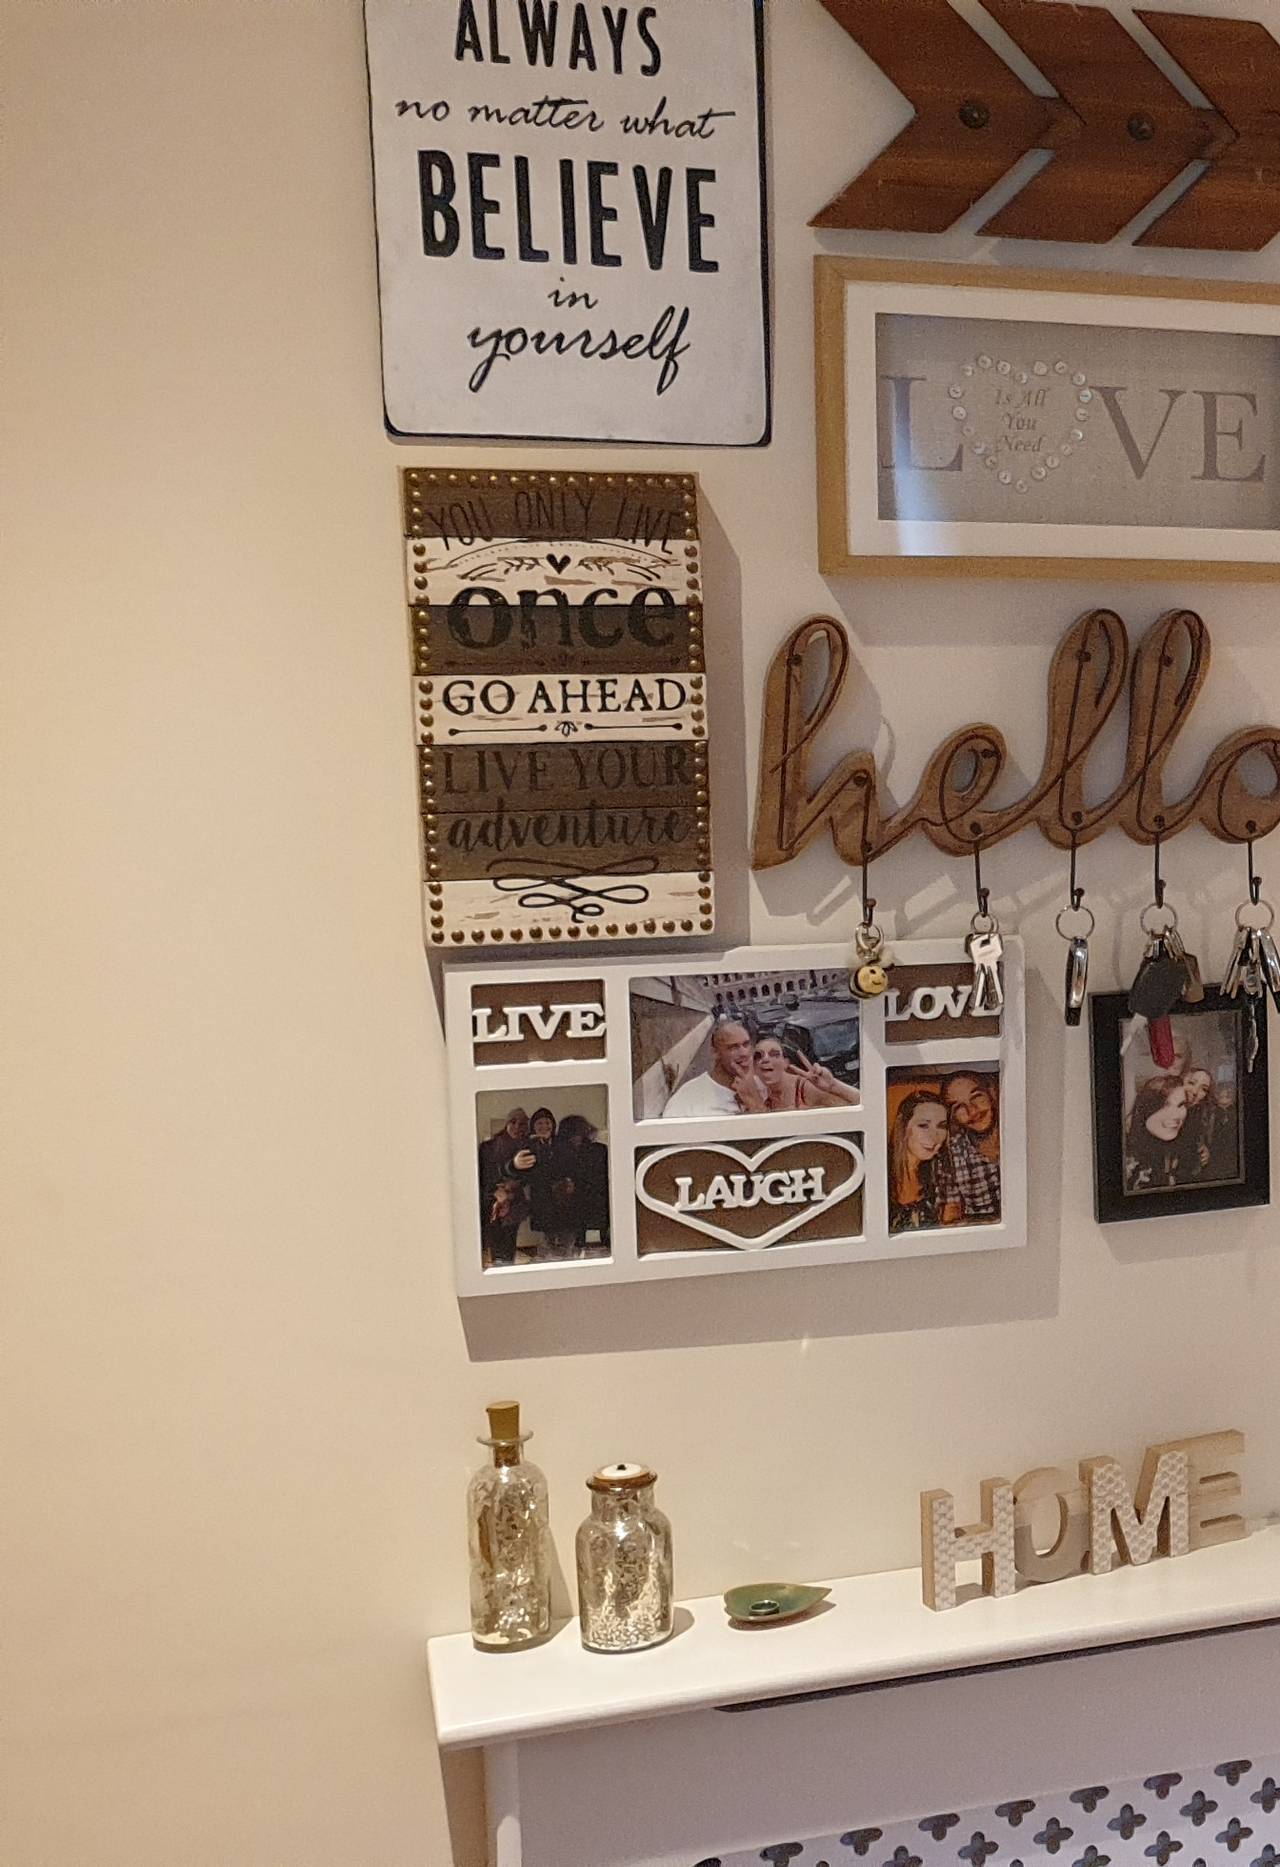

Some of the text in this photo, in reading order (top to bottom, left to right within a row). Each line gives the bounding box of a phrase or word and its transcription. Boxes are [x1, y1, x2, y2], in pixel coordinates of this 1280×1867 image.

[455, 0, 662, 77] ALWAYS
[395, 94, 736, 139] no matter what
[417, 149, 720, 273] BELIEVE
[547, 276, 599, 310] in
[466, 305, 691, 396] yourself
[994, 433, 1046, 453] Need
[1001, 411, 1038, 431] You
[426, 490, 682, 555] YOU ONLY LIVE
[447, 585, 676, 649] once
[442, 677, 686, 716] GO AHEAD
[443, 744, 693, 794] LIVE YOUR
[448, 798, 692, 852] adventure
[472, 1001, 607, 1045] LIVE
[673, 1165, 828, 1213] LAUGH
[920, 1428, 1251, 1612] HOME
